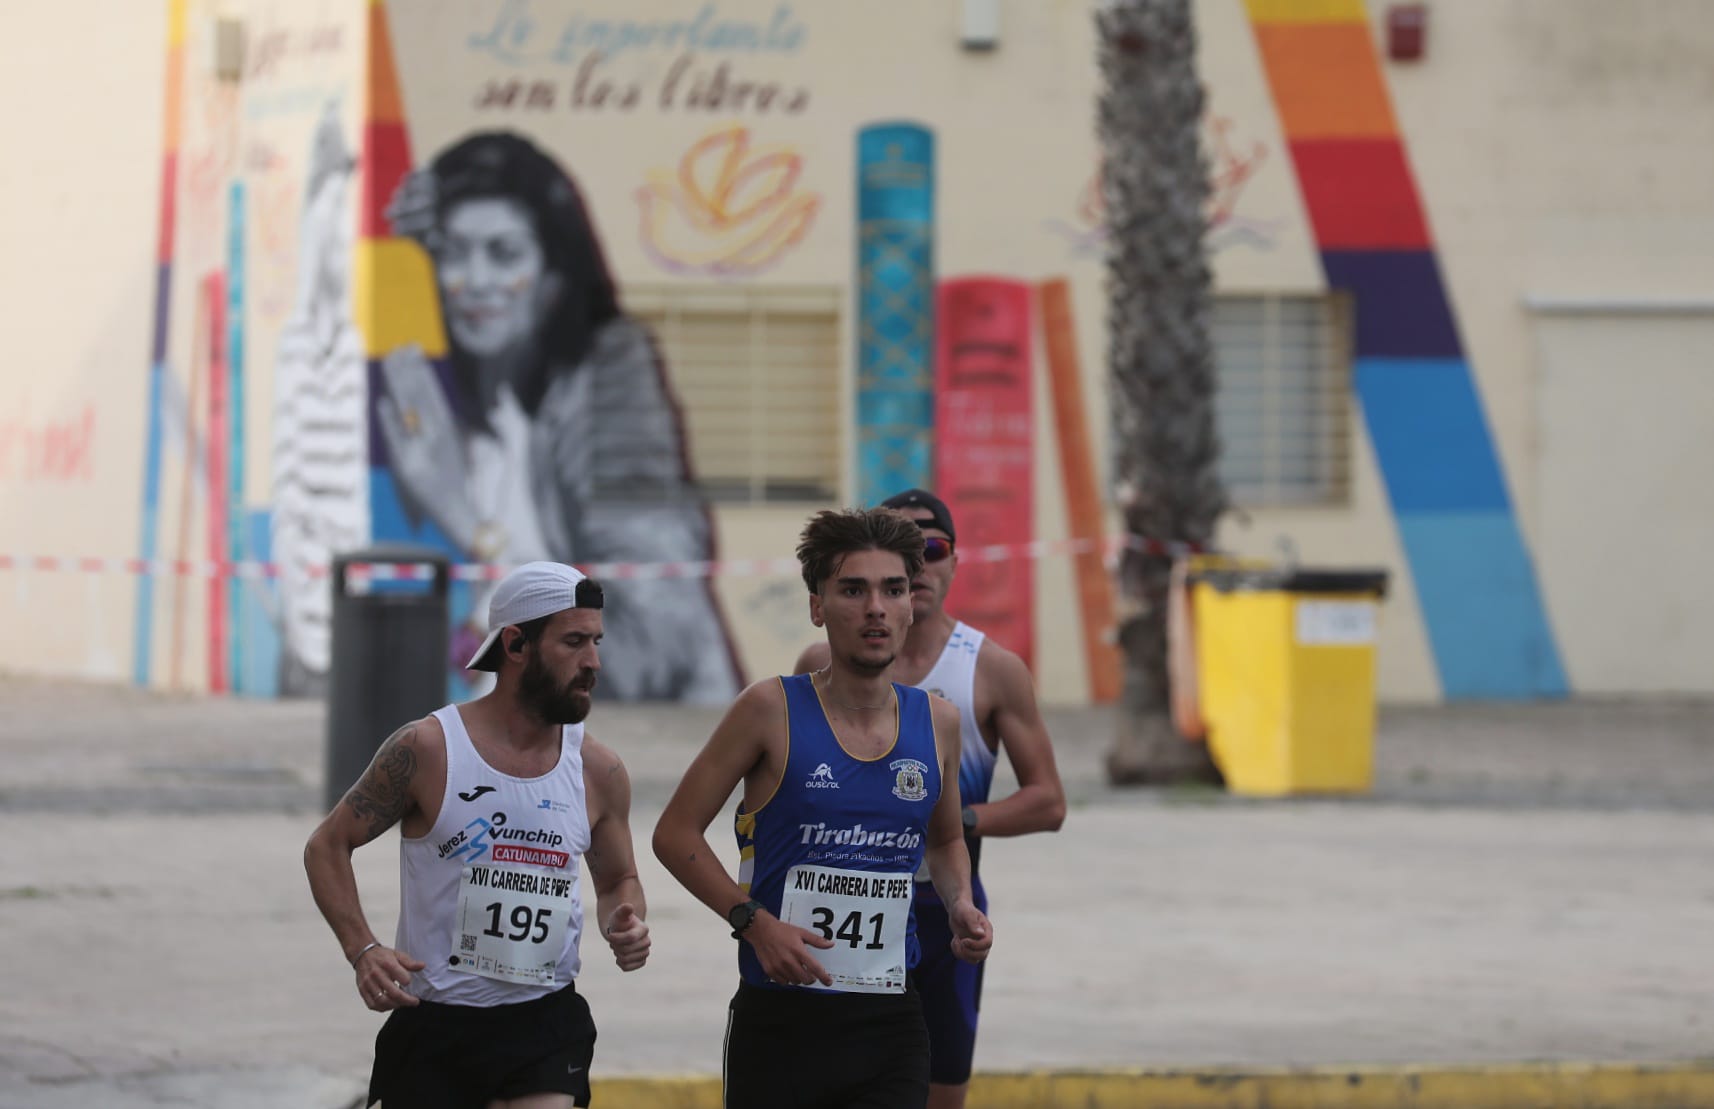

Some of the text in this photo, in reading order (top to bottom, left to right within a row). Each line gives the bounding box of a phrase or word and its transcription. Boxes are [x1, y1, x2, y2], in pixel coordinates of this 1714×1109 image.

[438, 829, 468, 858] Jerez
[800, 823, 920, 849] Tirabuzón
[470, 867, 489, 884] XVI
[491, 869, 537, 892] CARRERA
[540, 878, 550, 896] DE
[795, 870, 908, 899] XVI CARRERA DE PEPE
[483, 902, 552, 944] 195
[811, 907, 884, 950] 341
